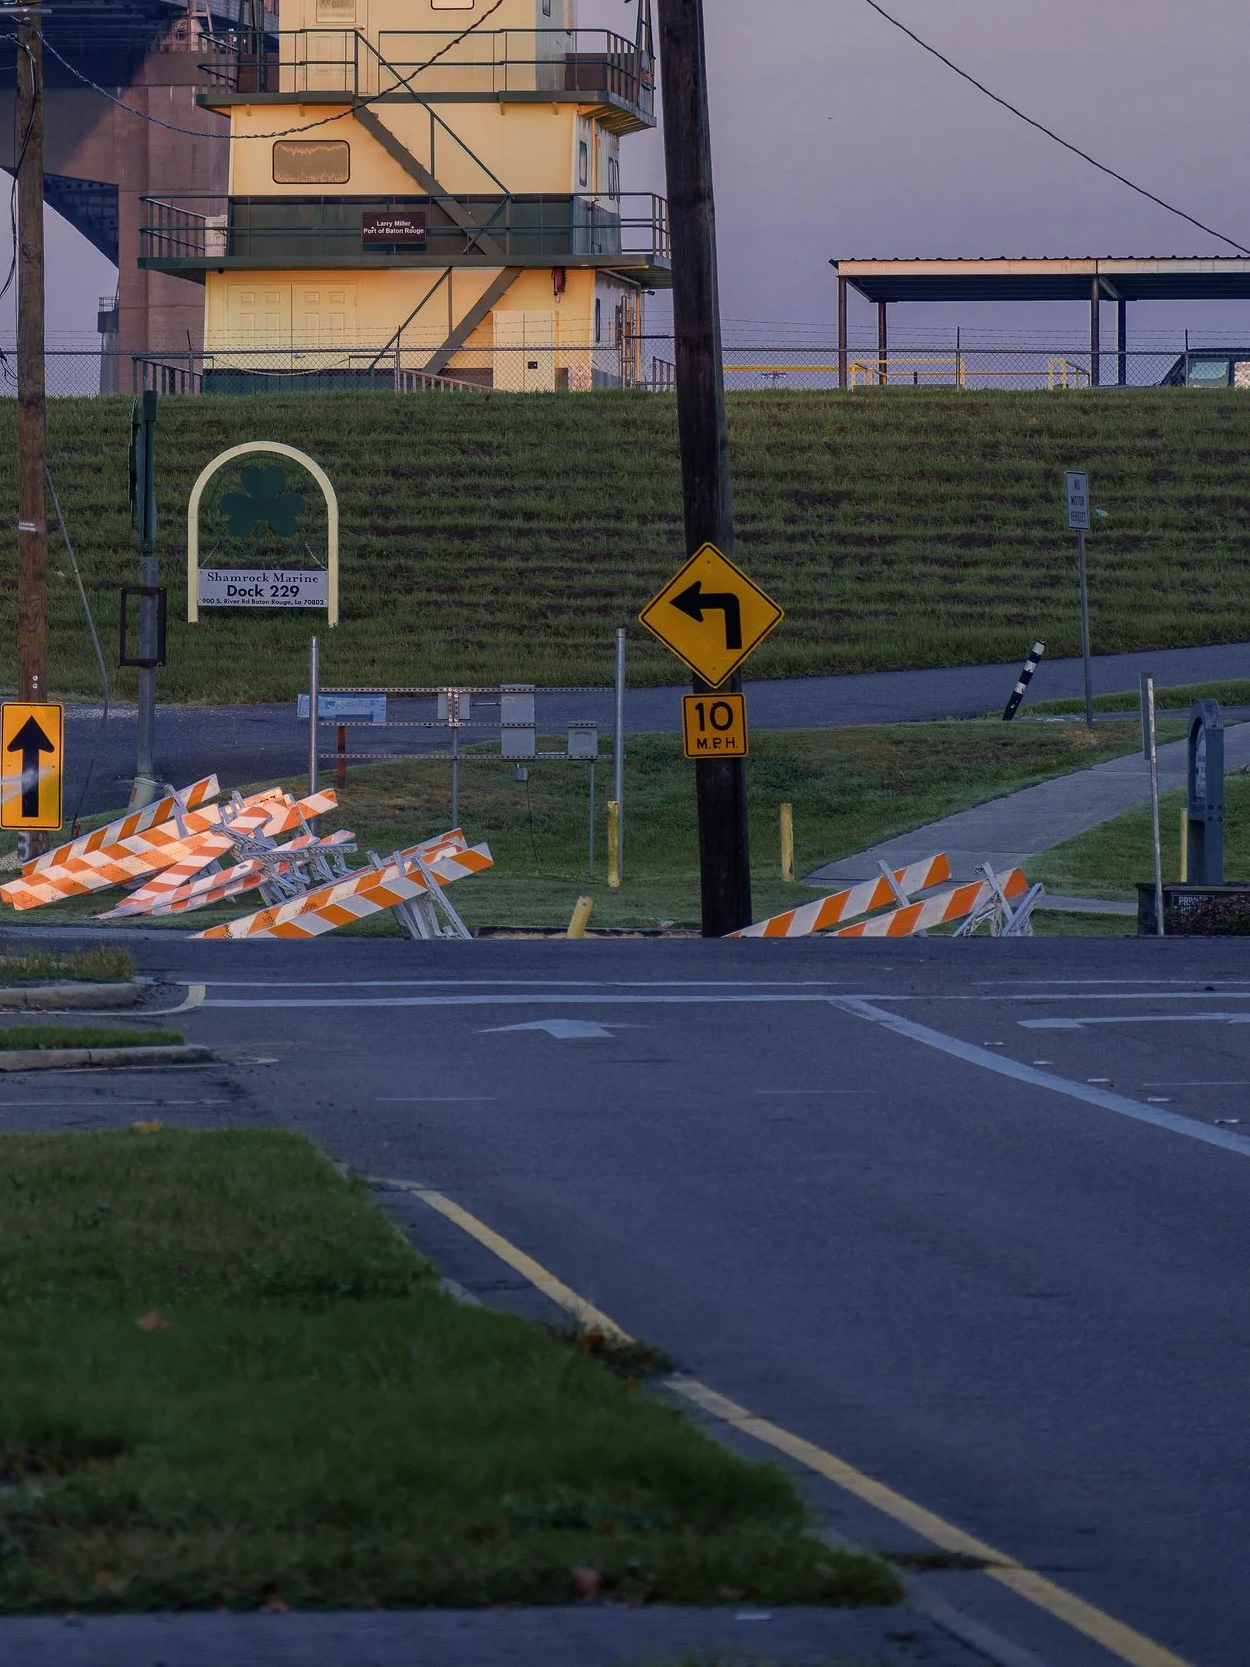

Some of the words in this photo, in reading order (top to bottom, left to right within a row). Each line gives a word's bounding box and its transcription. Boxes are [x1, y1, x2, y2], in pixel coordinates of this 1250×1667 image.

[206, 572, 270, 582] Shamrock
[273, 573, 319, 583] Marine
[227, 584, 265, 597] Dock
[269, 585, 300, 597] 229
[694, 700, 734, 732] 10
[696, 737, 739, 750] M.P.H.
